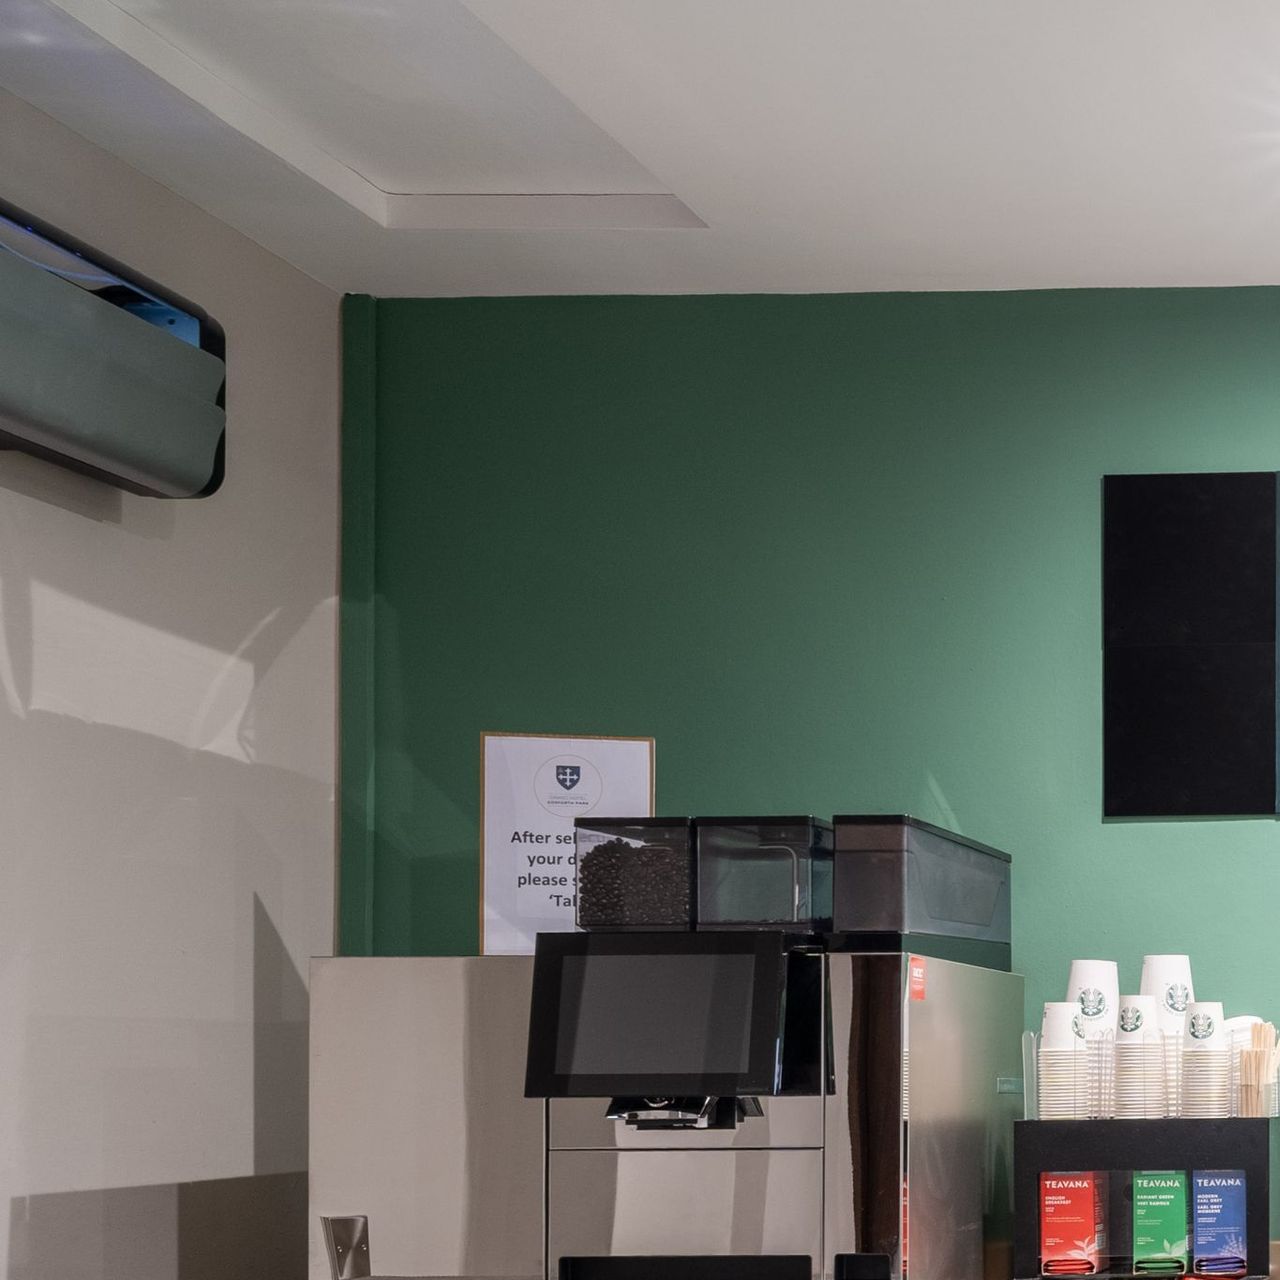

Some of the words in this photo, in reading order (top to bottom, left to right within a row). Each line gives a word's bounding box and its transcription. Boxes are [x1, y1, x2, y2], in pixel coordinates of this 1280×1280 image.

[511, 831, 551, 844] After
[527, 854, 563, 867] your
[517, 872, 568, 888] please
